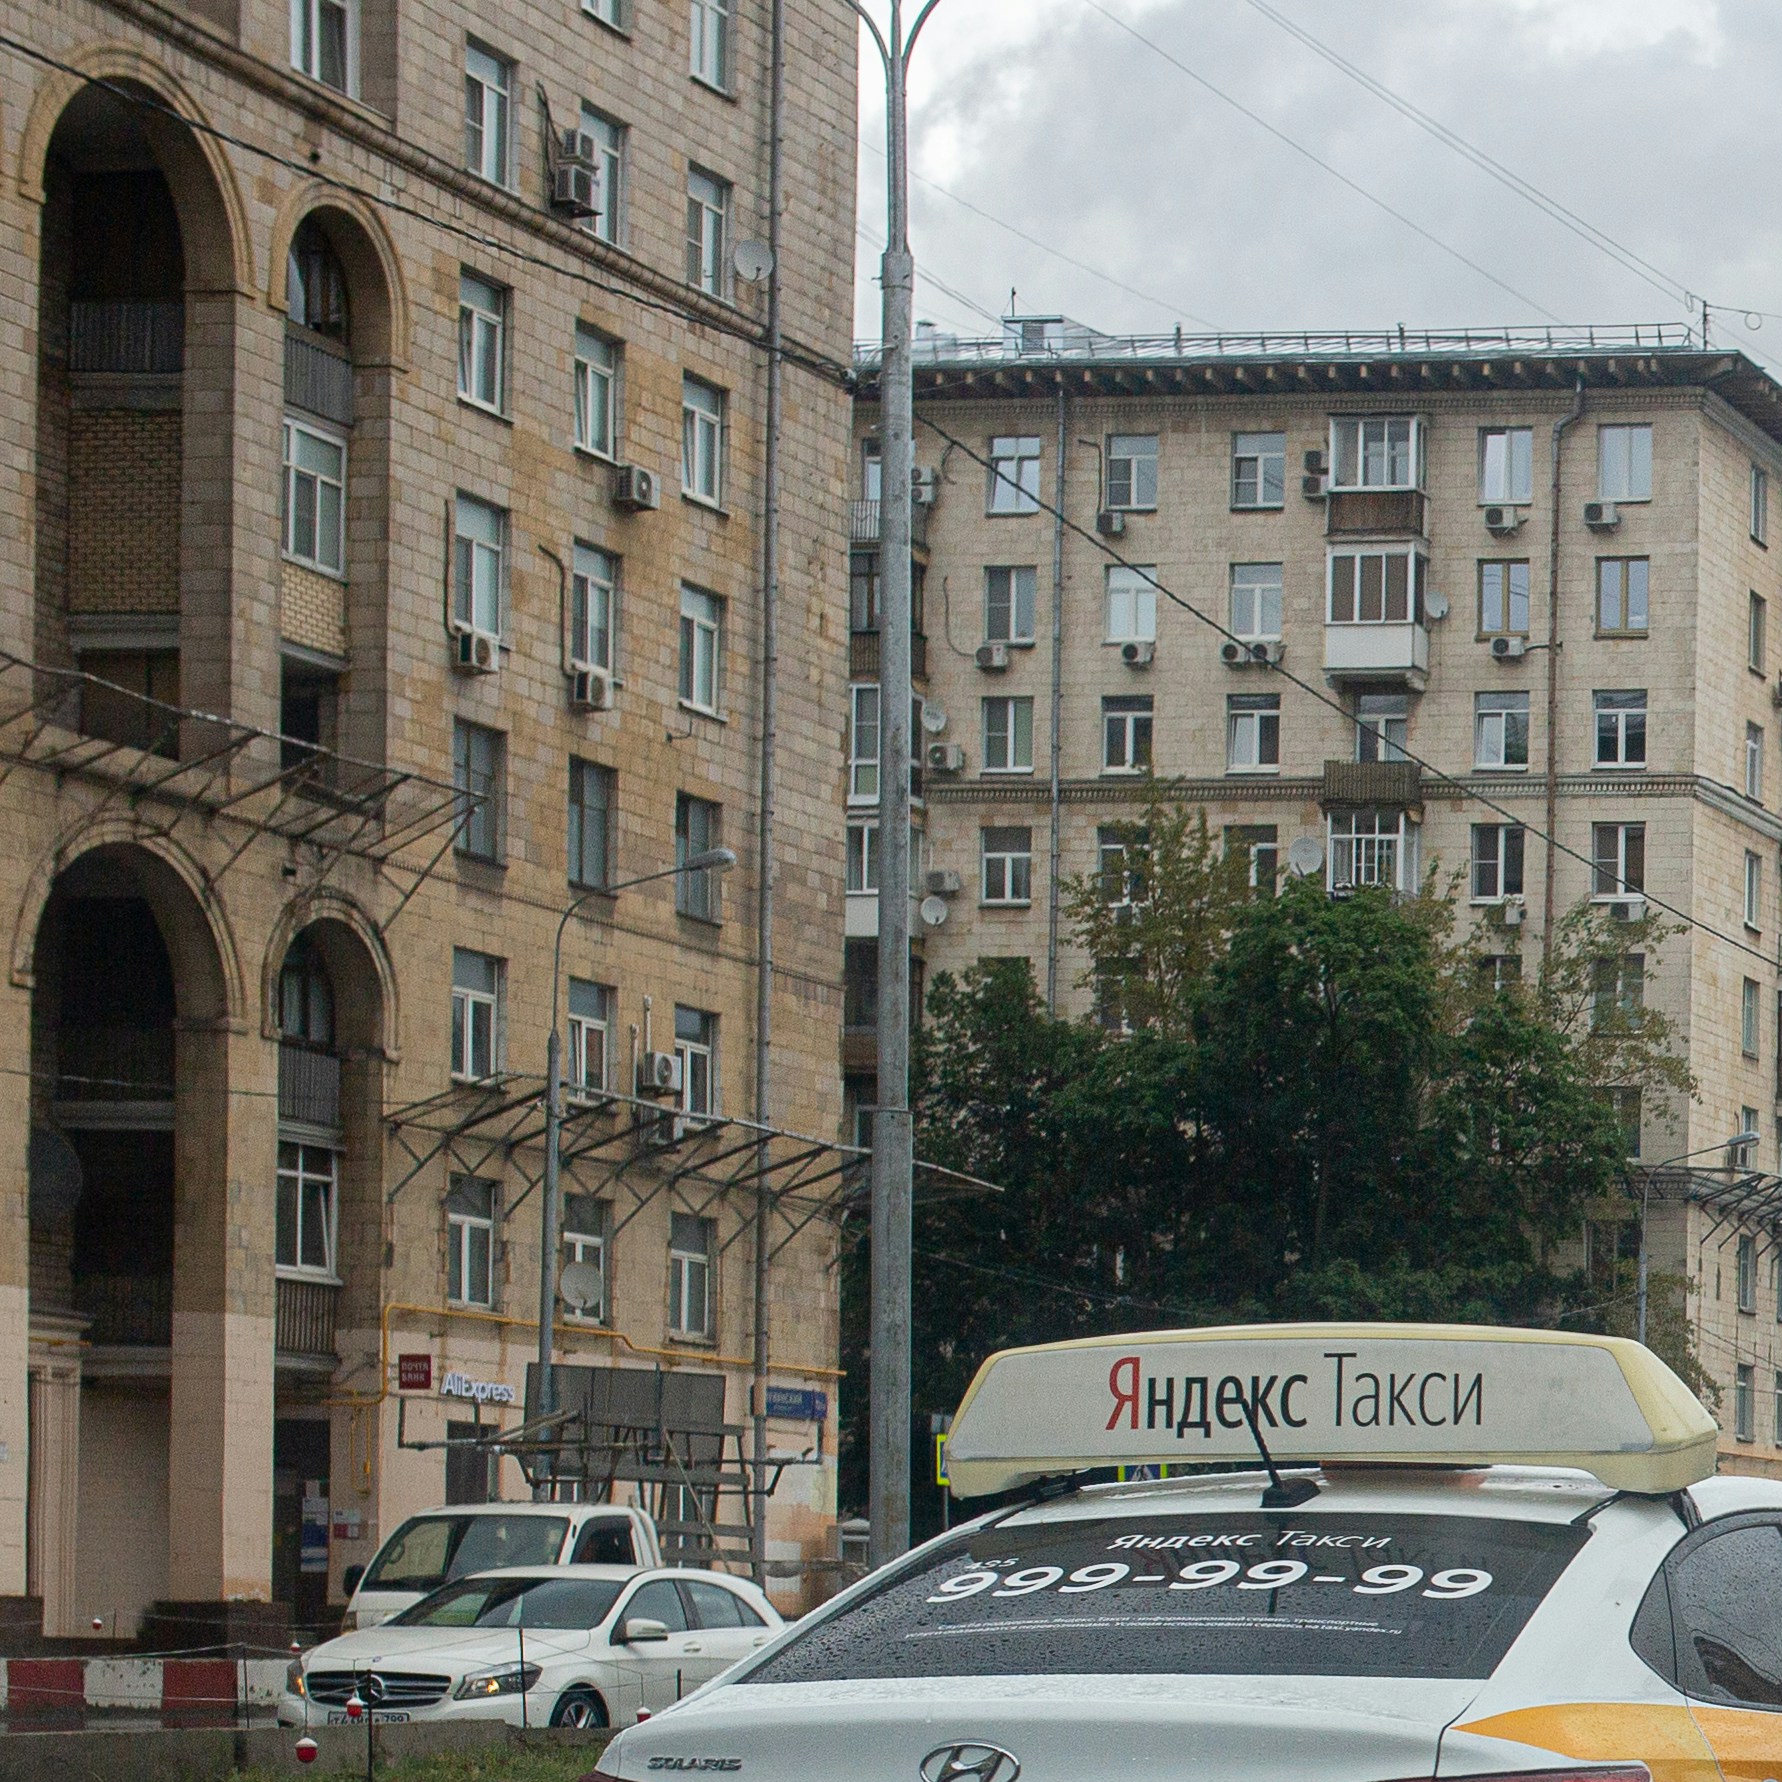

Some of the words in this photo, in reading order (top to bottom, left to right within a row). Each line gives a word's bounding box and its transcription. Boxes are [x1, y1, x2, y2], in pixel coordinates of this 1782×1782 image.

[440, 1372, 515, 1403] AliExpress
[1104, 1355, 1308, 1438] Яндекс
[1323, 1353, 1484, 1428] Такси
[1106, 1531, 1262, 1550] Яндекс
[1276, 1530, 1392, 1549] Такси
[925, 1559, 1494, 1602] 999-99-99
